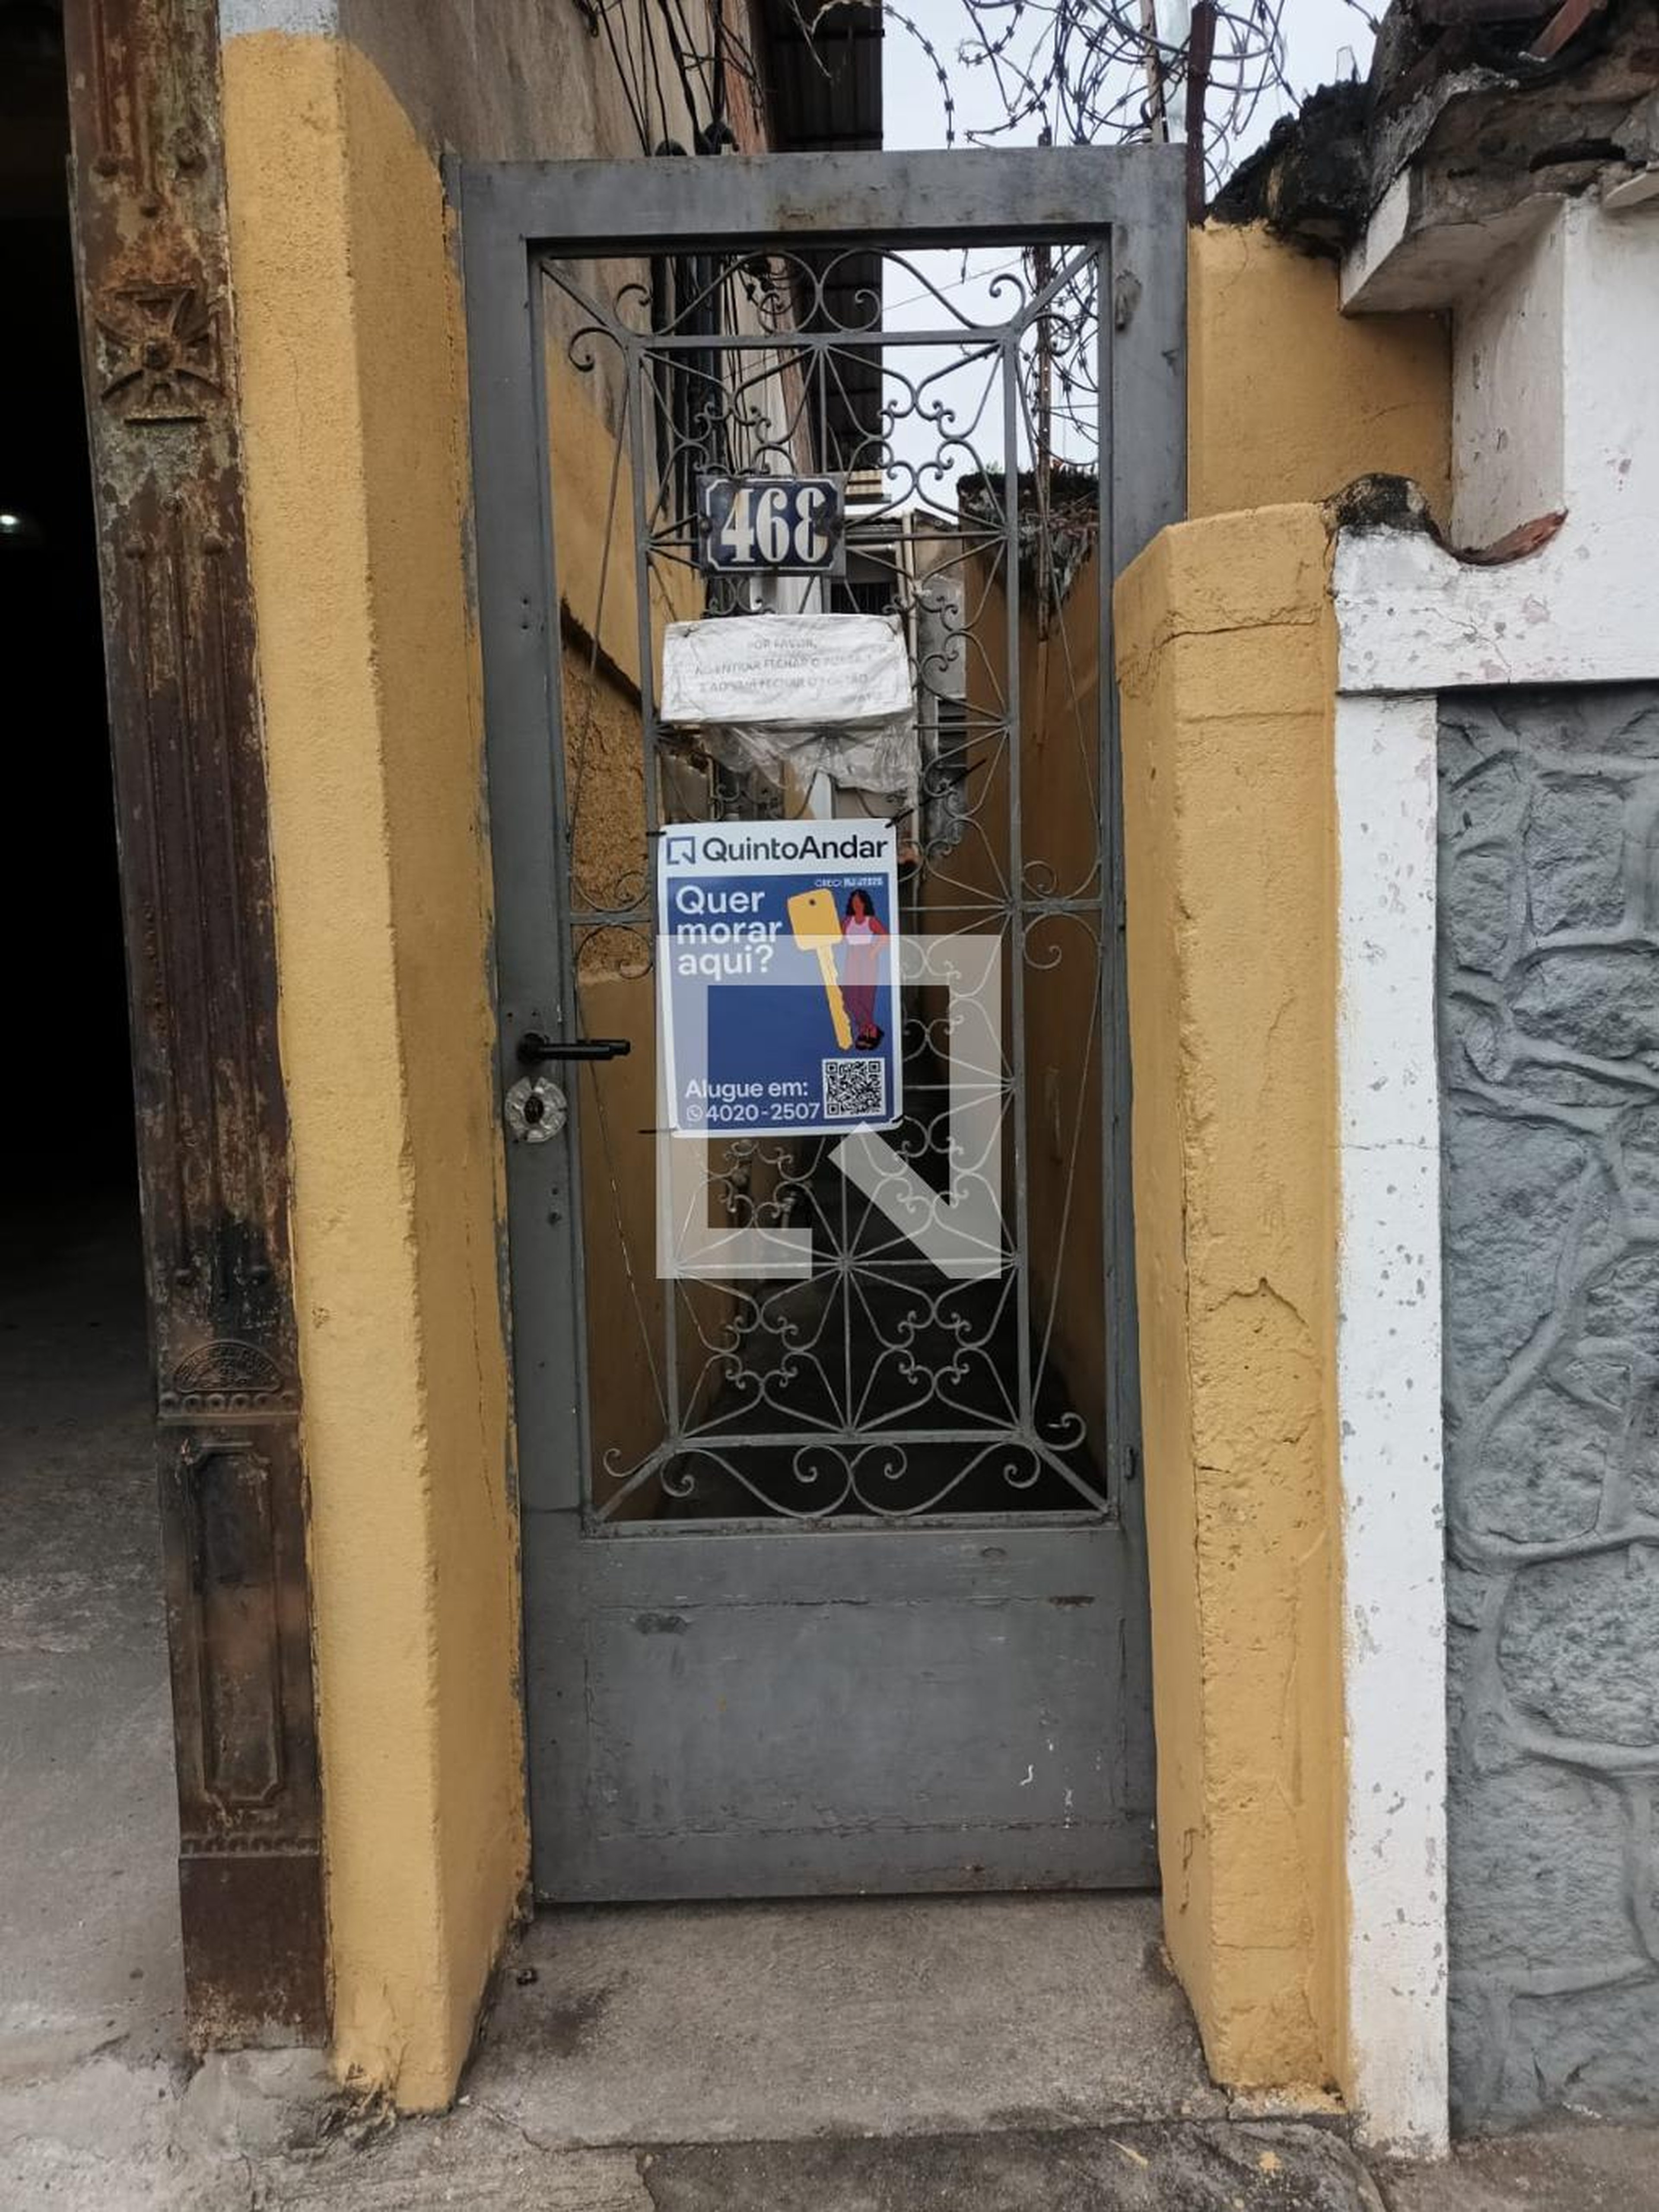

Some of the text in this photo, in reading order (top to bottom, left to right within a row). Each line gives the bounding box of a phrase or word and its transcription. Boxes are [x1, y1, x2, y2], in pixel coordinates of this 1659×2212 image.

[720, 487, 829, 563] 468
[702, 835, 888, 863] QuintoAndar
[675, 885, 765, 915] Quer
[677, 920, 783, 945] morar
[678, 944, 774, 981] aqui?
[685, 1080, 808, 1102] Alugue em:
